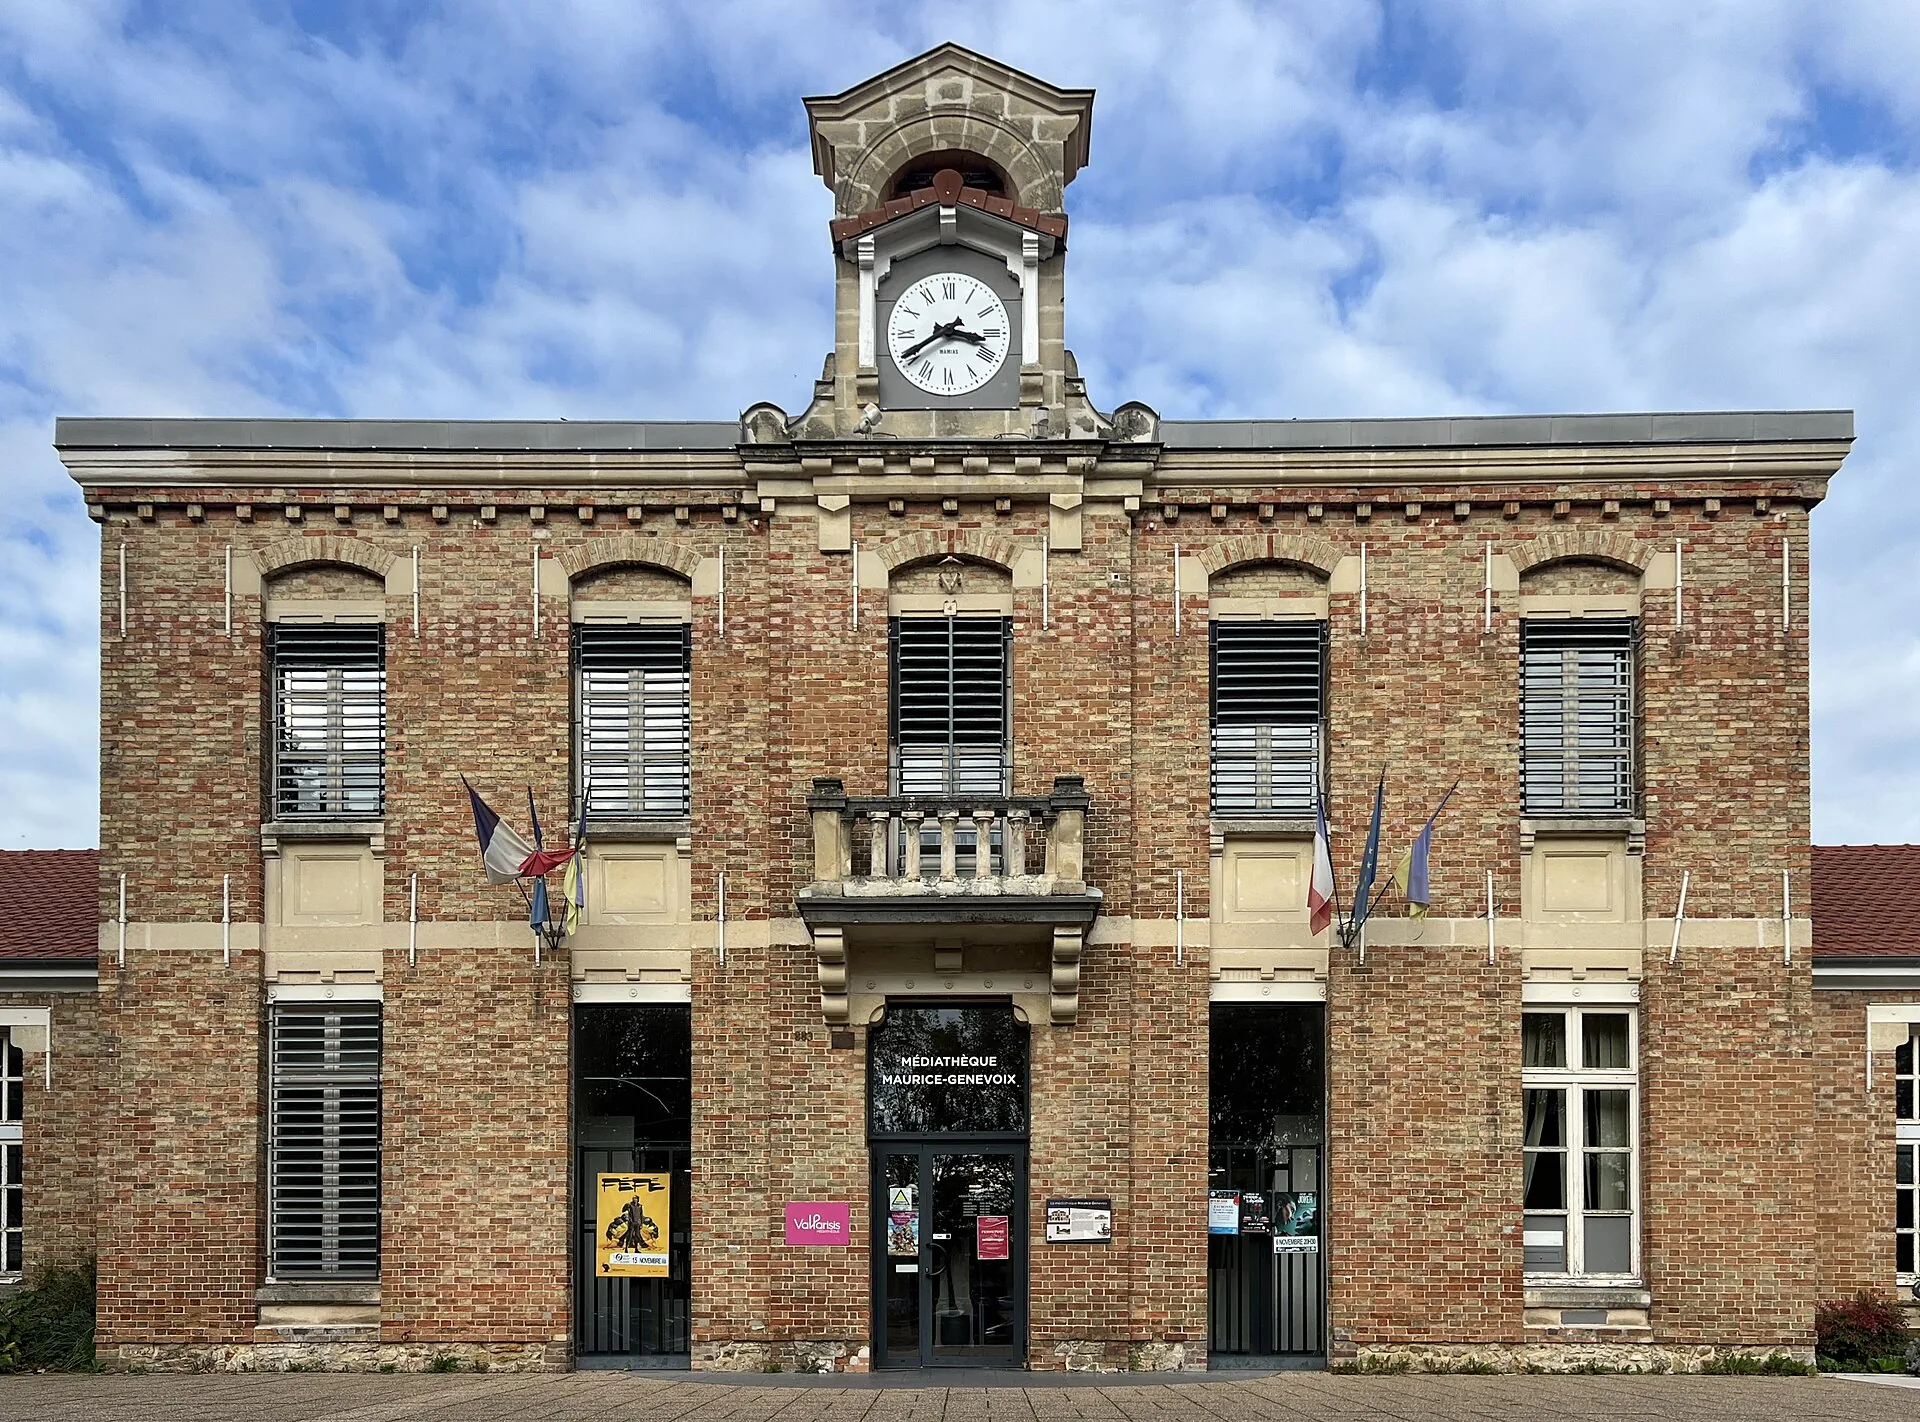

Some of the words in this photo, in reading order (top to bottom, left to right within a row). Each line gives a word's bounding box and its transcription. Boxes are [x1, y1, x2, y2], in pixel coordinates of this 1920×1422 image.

[901, 1054, 997, 1067] MÉDIATHÈQUE
[882, 1074, 1016, 1085] MAURICE-GENEVOIX
[602, 1177, 666, 1192] FÉFÉ
